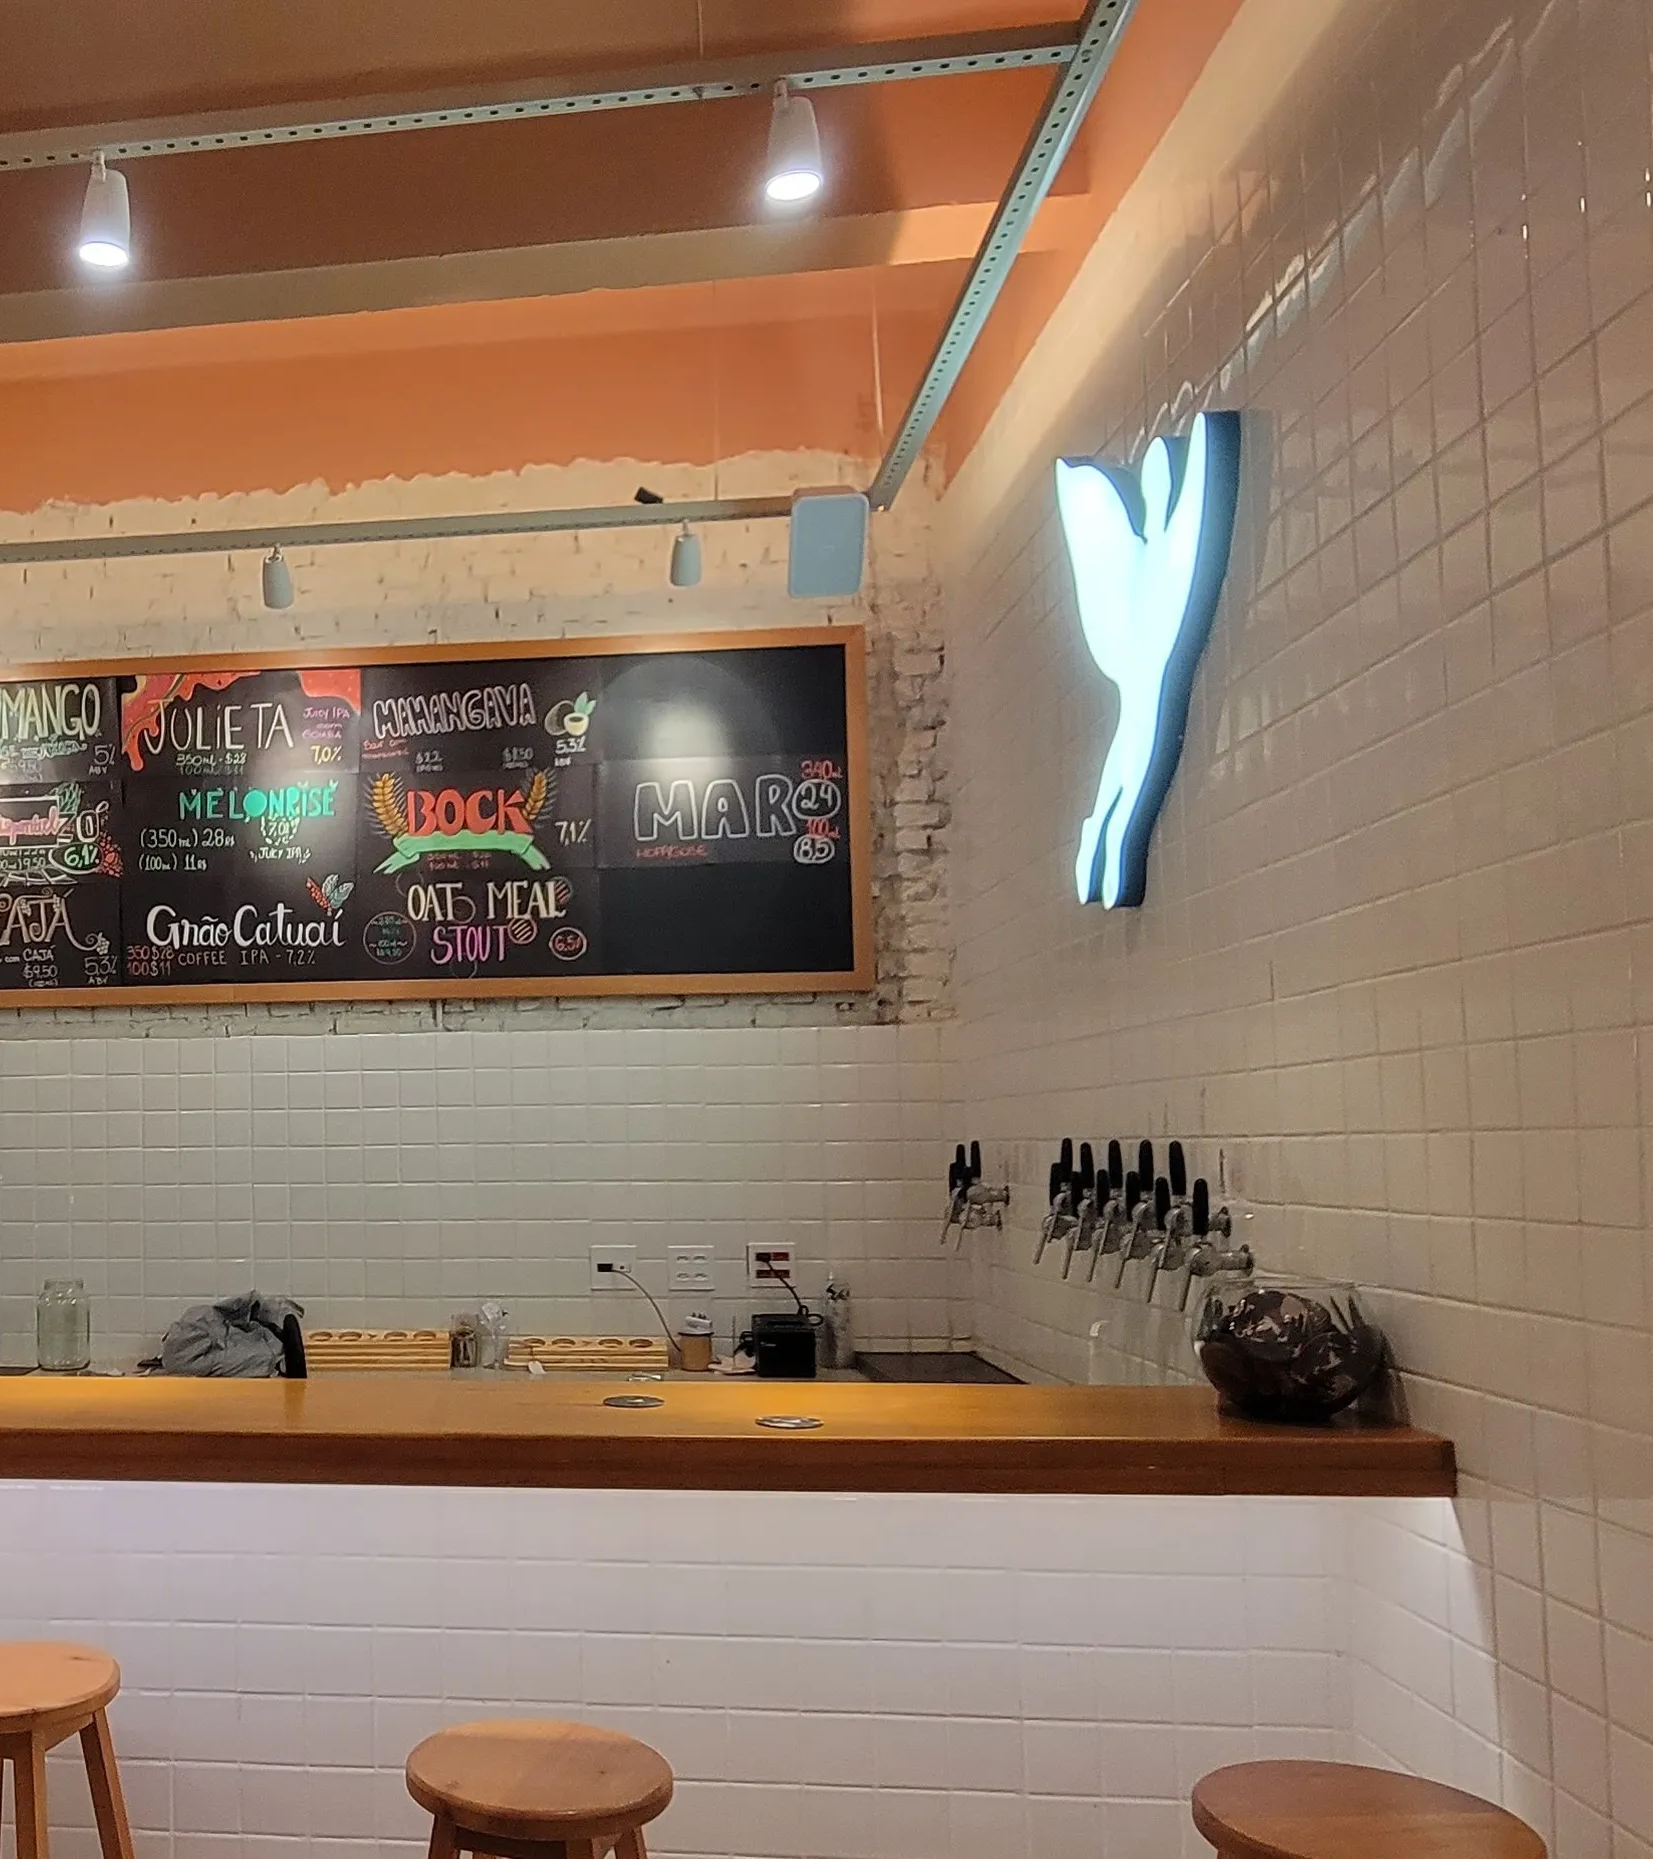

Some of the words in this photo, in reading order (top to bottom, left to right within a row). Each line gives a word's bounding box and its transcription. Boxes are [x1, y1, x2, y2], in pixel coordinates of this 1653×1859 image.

[332, 706, 350, 719] IPA
[373, 683, 536, 739] MAMANGAVA
[179, 784, 335, 821] MELONRISE
[406, 788, 535, 836] BOCK
[634, 774, 797, 842] MAR
[800, 783, 834, 811] 24
[407, 882, 464, 922] OAT
[487, 880, 567, 920] MEAL
[234, 902, 346, 948] Catuaí
[430, 924, 509, 965] STOUT
[178, 951, 227, 966] COFFEE
[241, 951, 269, 965] IPA
